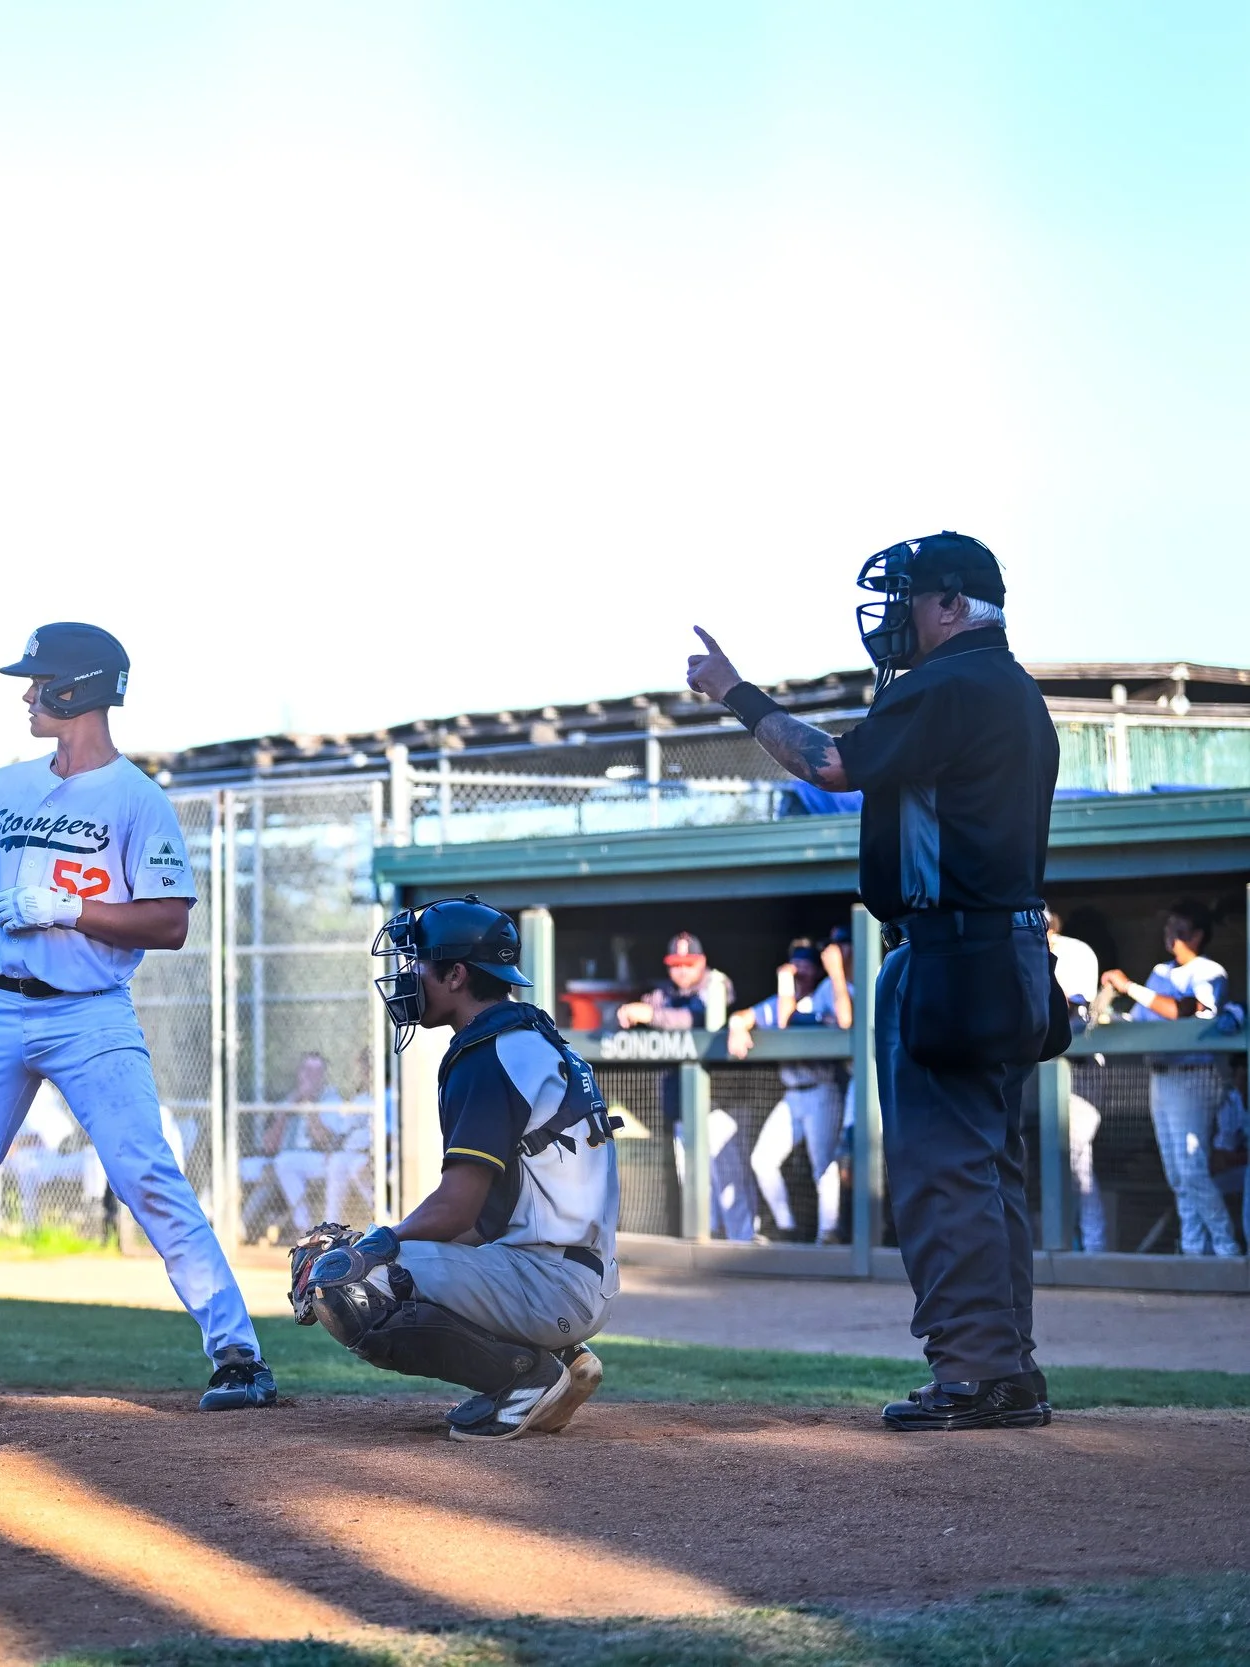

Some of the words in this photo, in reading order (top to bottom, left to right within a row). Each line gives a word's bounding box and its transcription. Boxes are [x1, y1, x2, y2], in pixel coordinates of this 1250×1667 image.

[150, 856, 163, 865] Bank
[164, 857, 170, 865] of
[50, 858, 111, 899] 52
[601, 1030, 698, 1059] SONOMA
